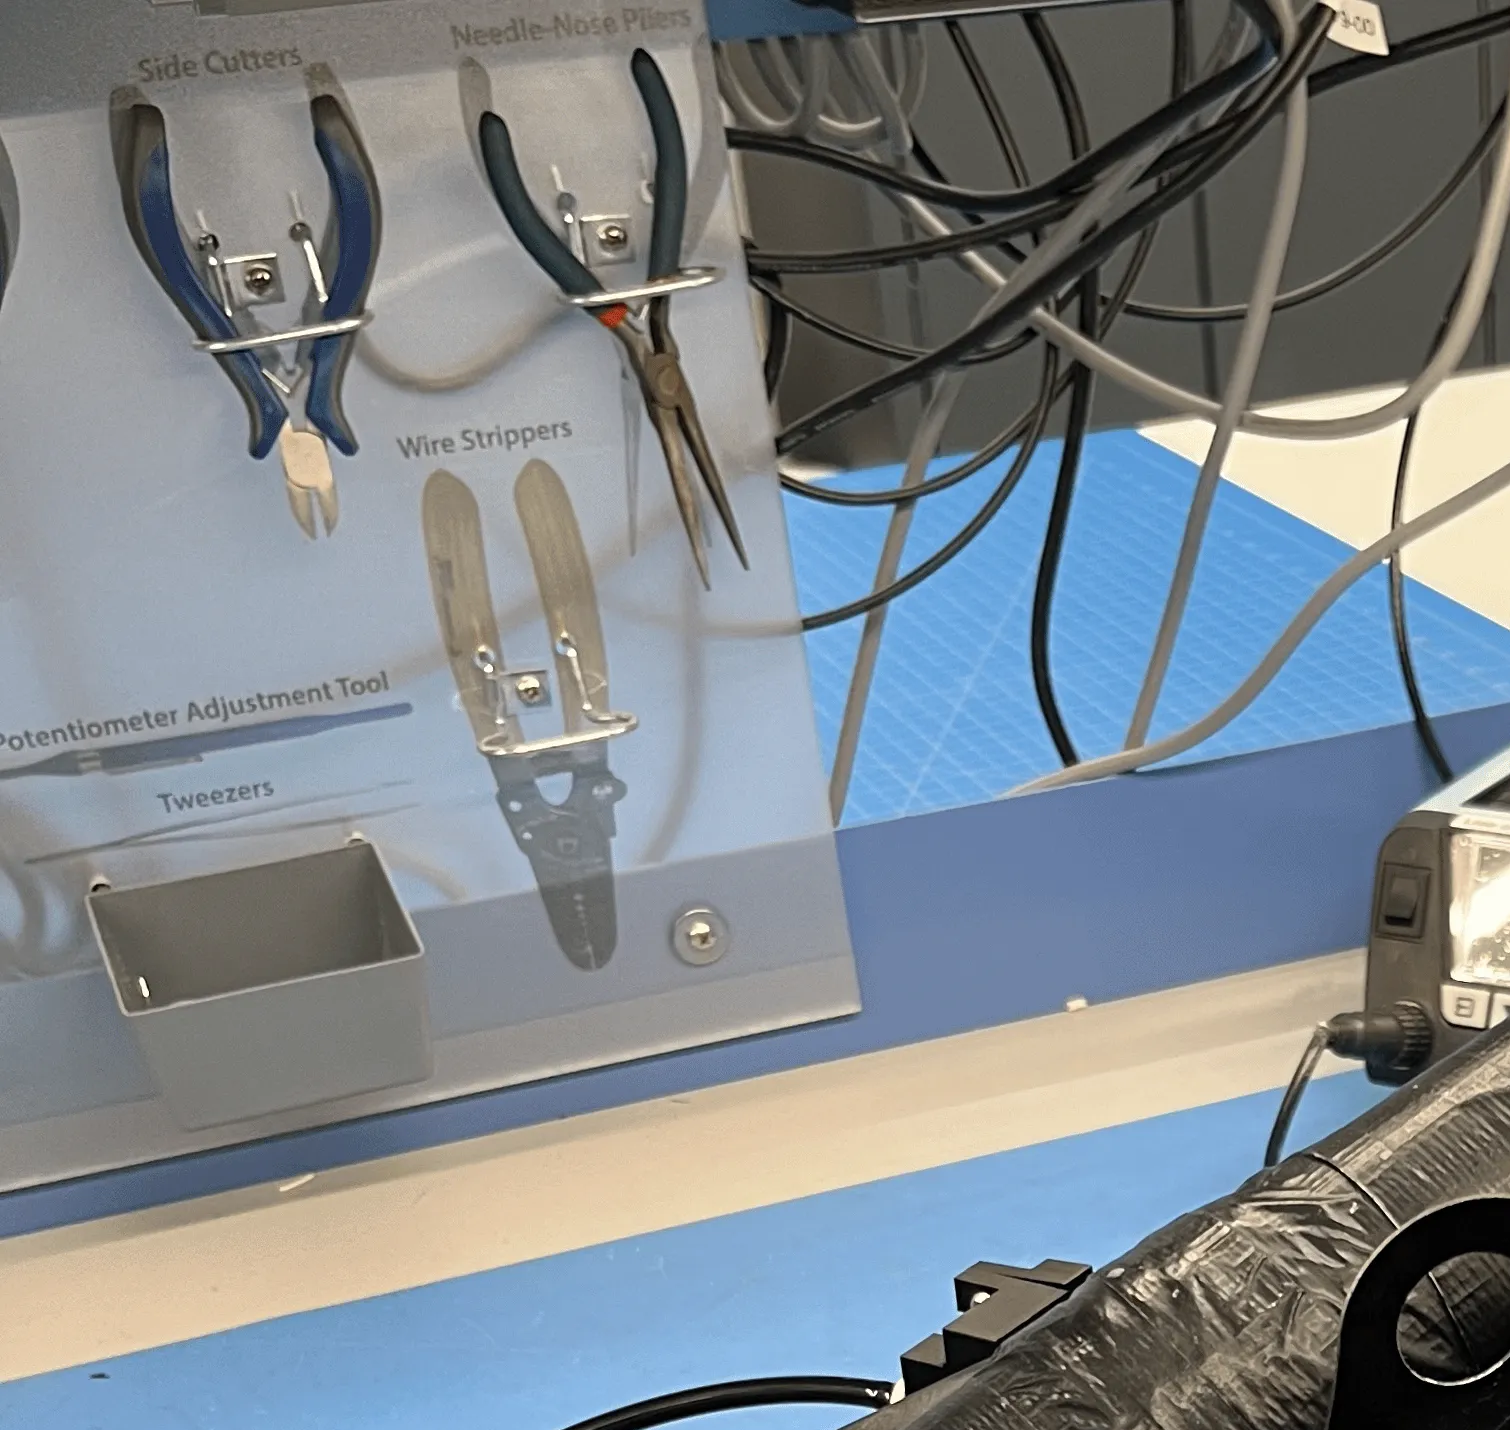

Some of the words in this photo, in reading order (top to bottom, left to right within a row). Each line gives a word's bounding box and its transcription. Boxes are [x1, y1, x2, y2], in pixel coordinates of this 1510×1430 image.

[450, 13, 618, 49] Needle-Nose
[622, 7, 692, 32] Pliers
[137, 54, 199, 82] Side
[203, 48, 302, 75] Cutters
[396, 434, 456, 459] Wire
[460, 420, 572, 451] Strippers
[187, 681, 332, 723] Adjustment
[334, 670, 390, 698] Tool
[156, 779, 275, 814] Tweezers
